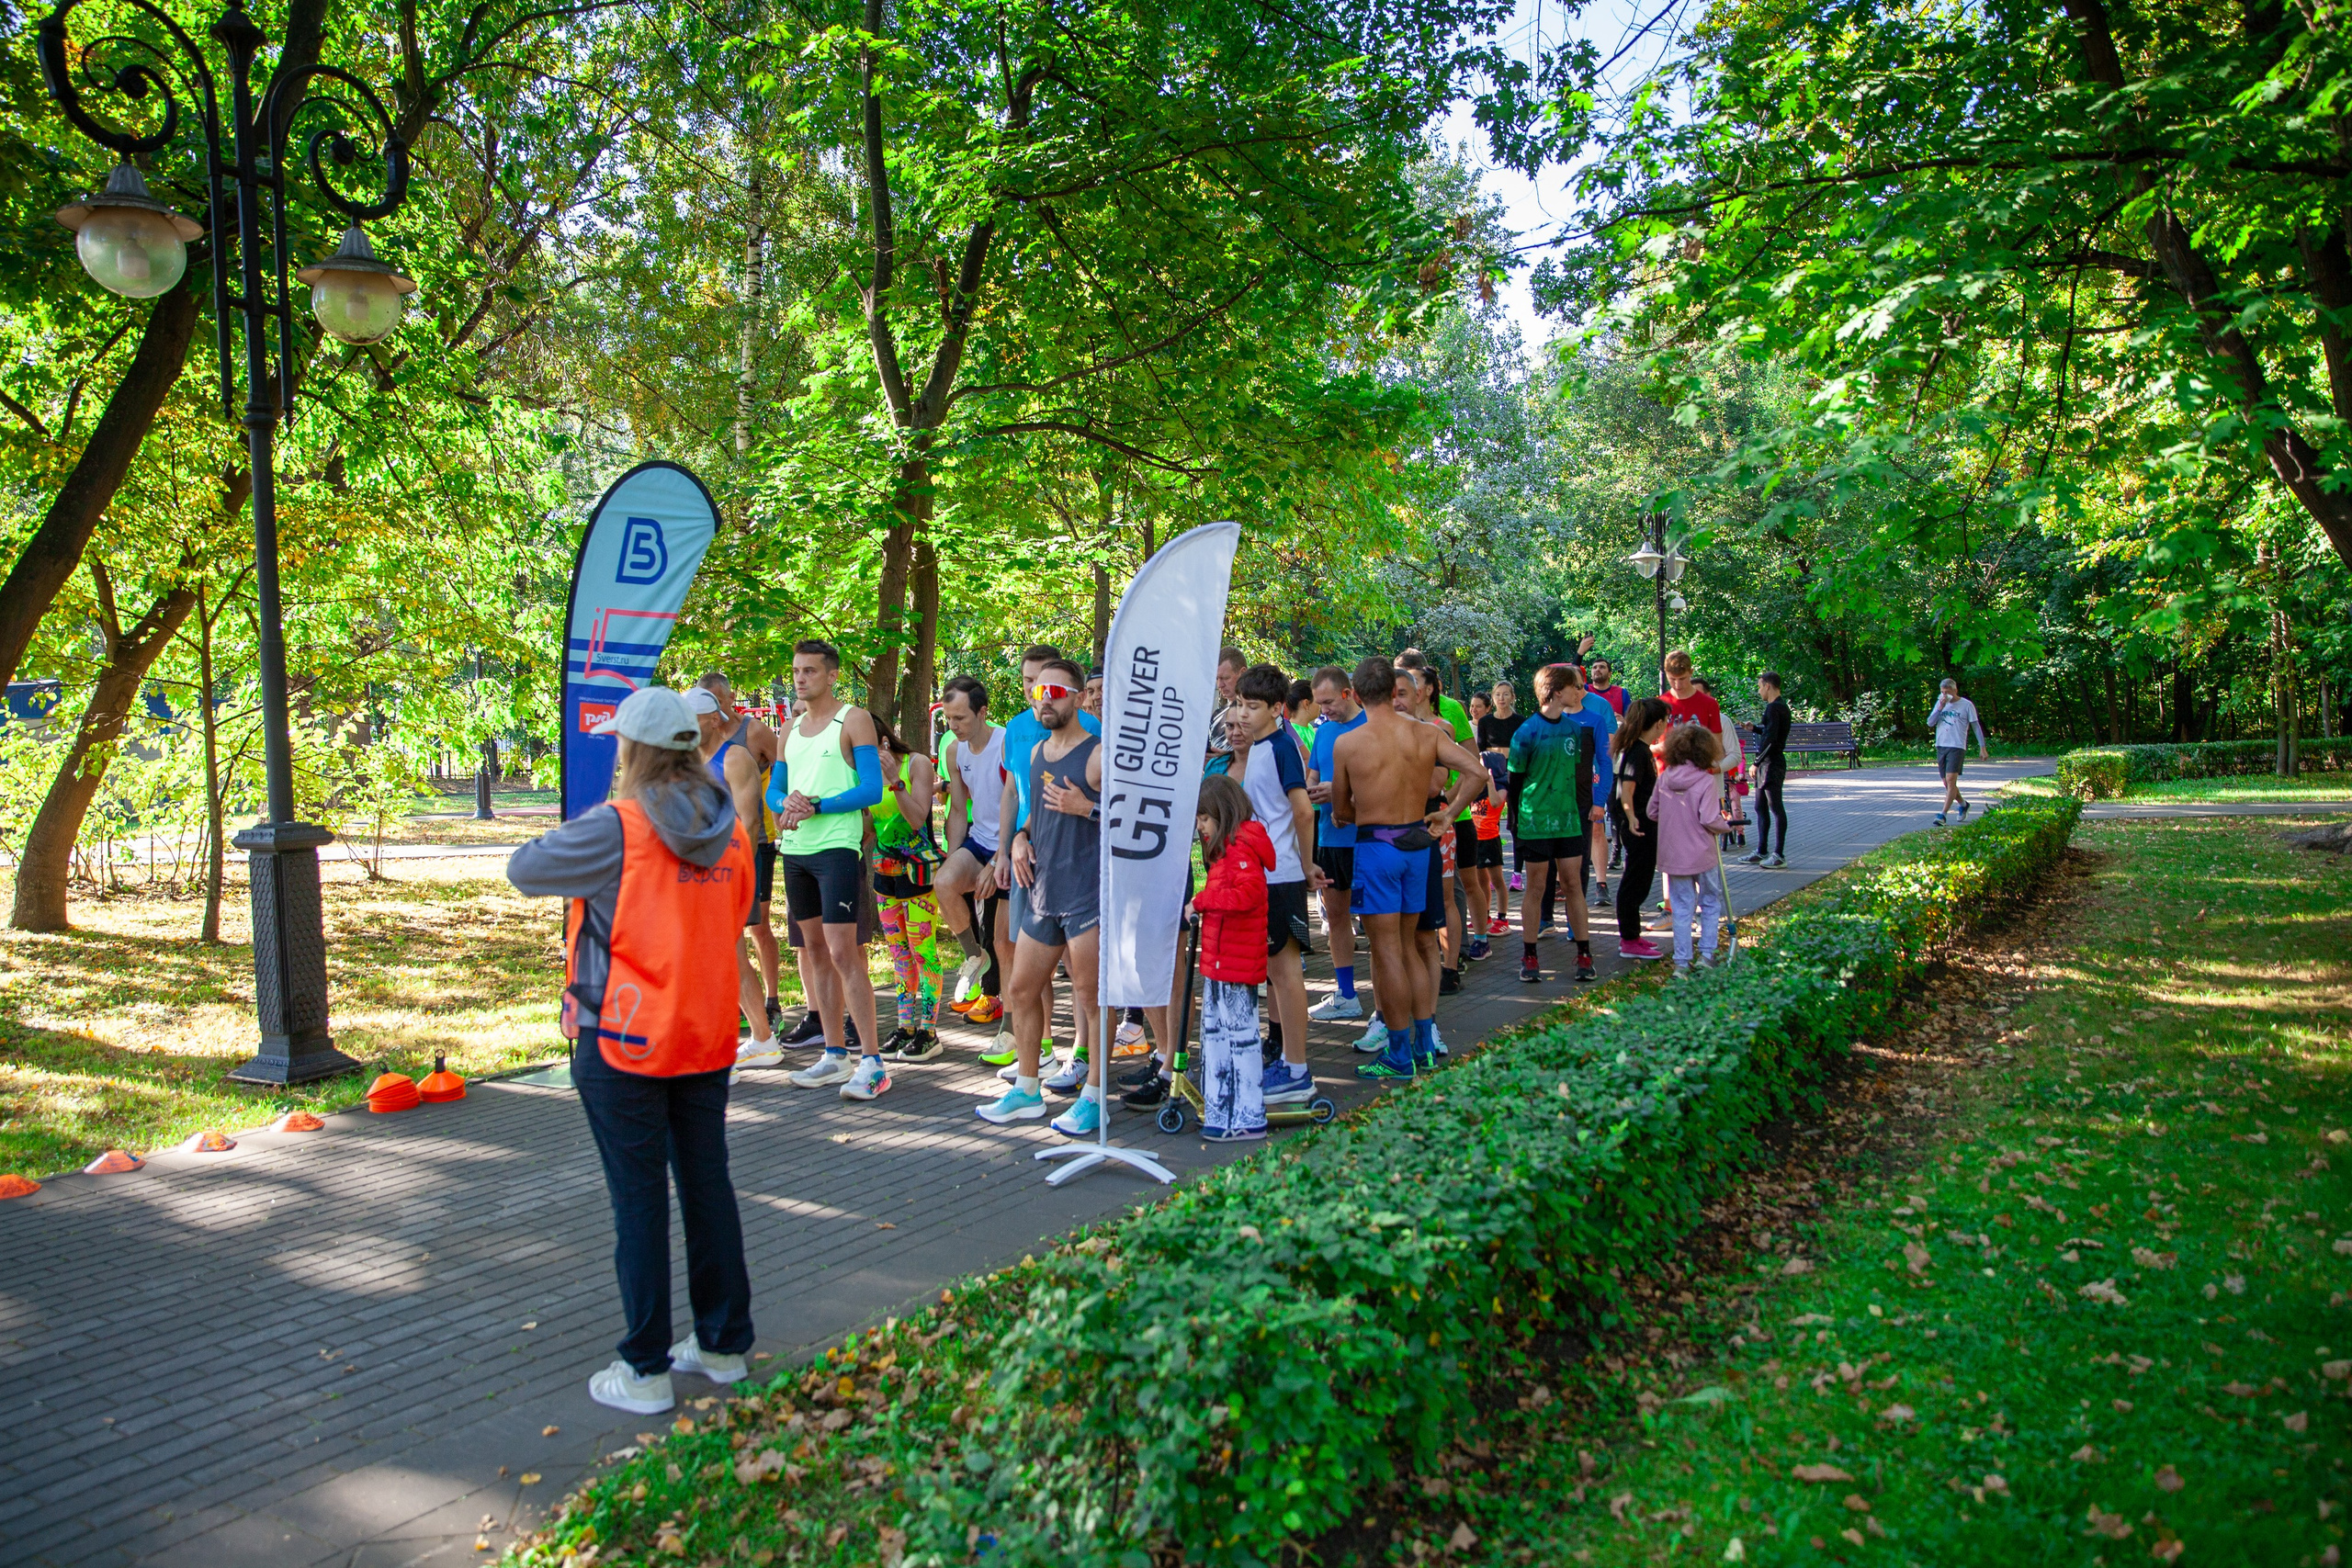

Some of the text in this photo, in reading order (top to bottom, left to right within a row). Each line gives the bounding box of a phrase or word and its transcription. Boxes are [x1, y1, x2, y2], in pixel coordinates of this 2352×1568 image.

[596, 653, 629, 665] 5verst.ru
[1114, 646, 1160, 773] GULLIVER
[1150, 686, 1184, 777] GROUP
